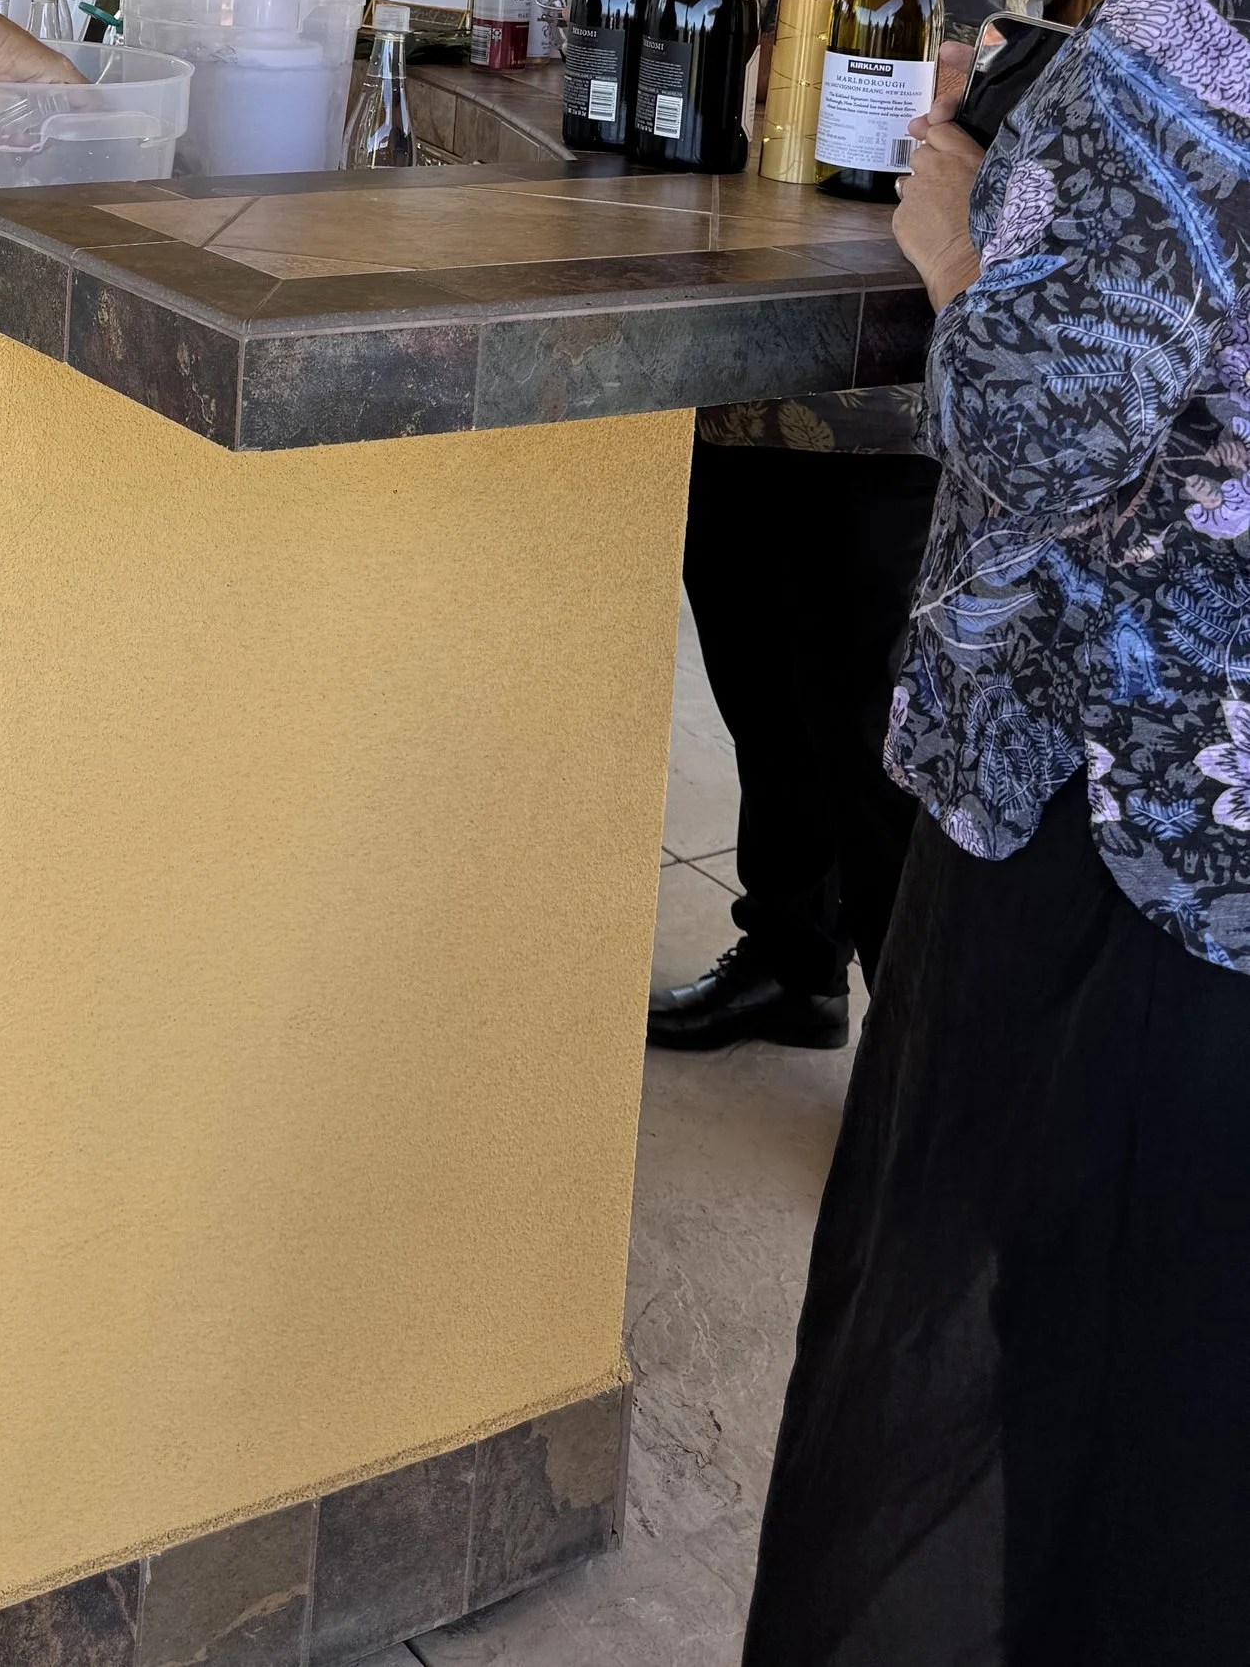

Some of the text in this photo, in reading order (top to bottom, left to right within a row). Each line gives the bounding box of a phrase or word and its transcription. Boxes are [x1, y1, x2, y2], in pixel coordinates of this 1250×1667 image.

[850, 61, 892, 72] KIRKLAND
[836, 75, 906, 88] MARLBOROUGH
[862, 86, 883, 95] BLANC
